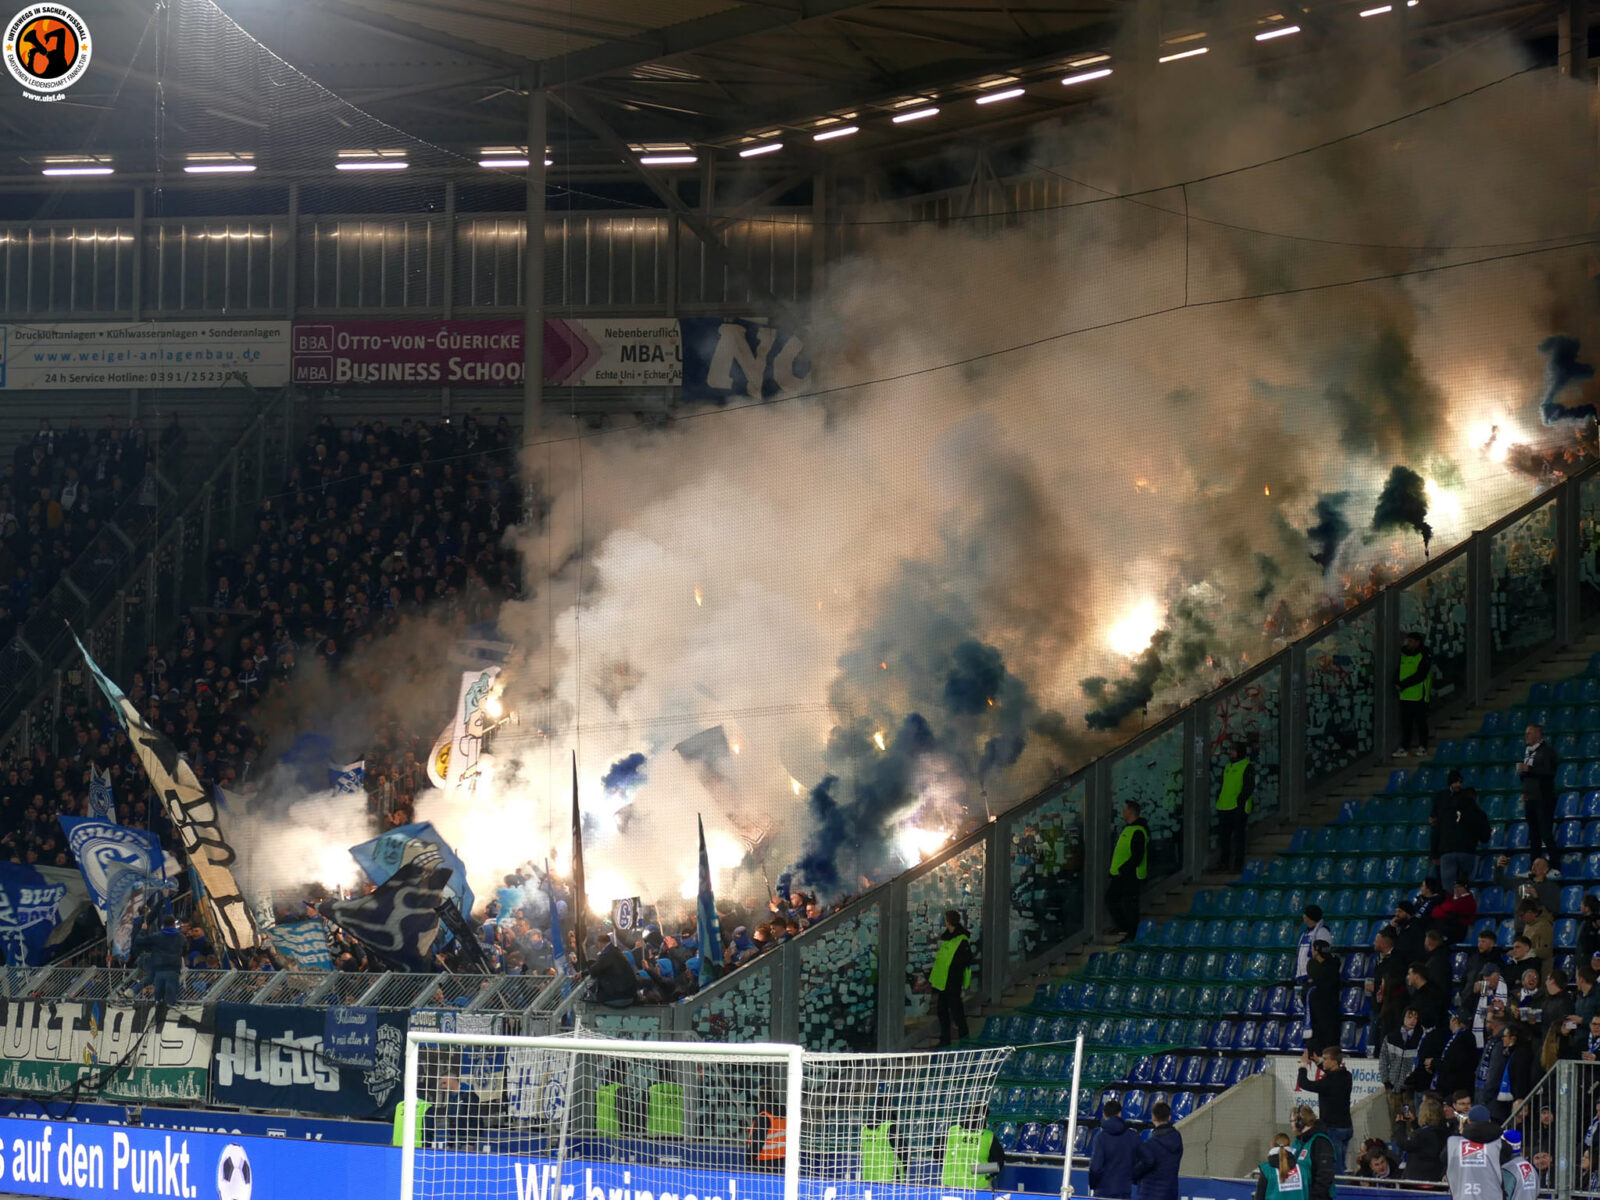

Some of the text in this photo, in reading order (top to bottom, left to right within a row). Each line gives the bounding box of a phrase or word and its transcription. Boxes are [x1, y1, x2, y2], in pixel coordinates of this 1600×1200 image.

[106, 328, 198, 340] Kühlwasseranlagen
[208, 327, 281, 339] Sonderanlagen
[604, 327, 679, 338] Nebenberuflich
[299, 336, 328, 350] BBA
[45, 374, 57, 383] 24
[60, 373, 66, 383] h
[69, 373, 105, 383] Service
[107, 373, 148, 383] Hotline:
[296, 366, 328, 380] MBA
[595, 370, 618, 379] Echte
[620, 369, 635, 379] Uni
[643, 369, 669, 379] Echter
[12, 1125, 53, 1184] auf
[58, 1128, 104, 1189] den
[112, 1131, 197, 1199] Punkt.
[1463, 1183, 1481, 1195] 25
